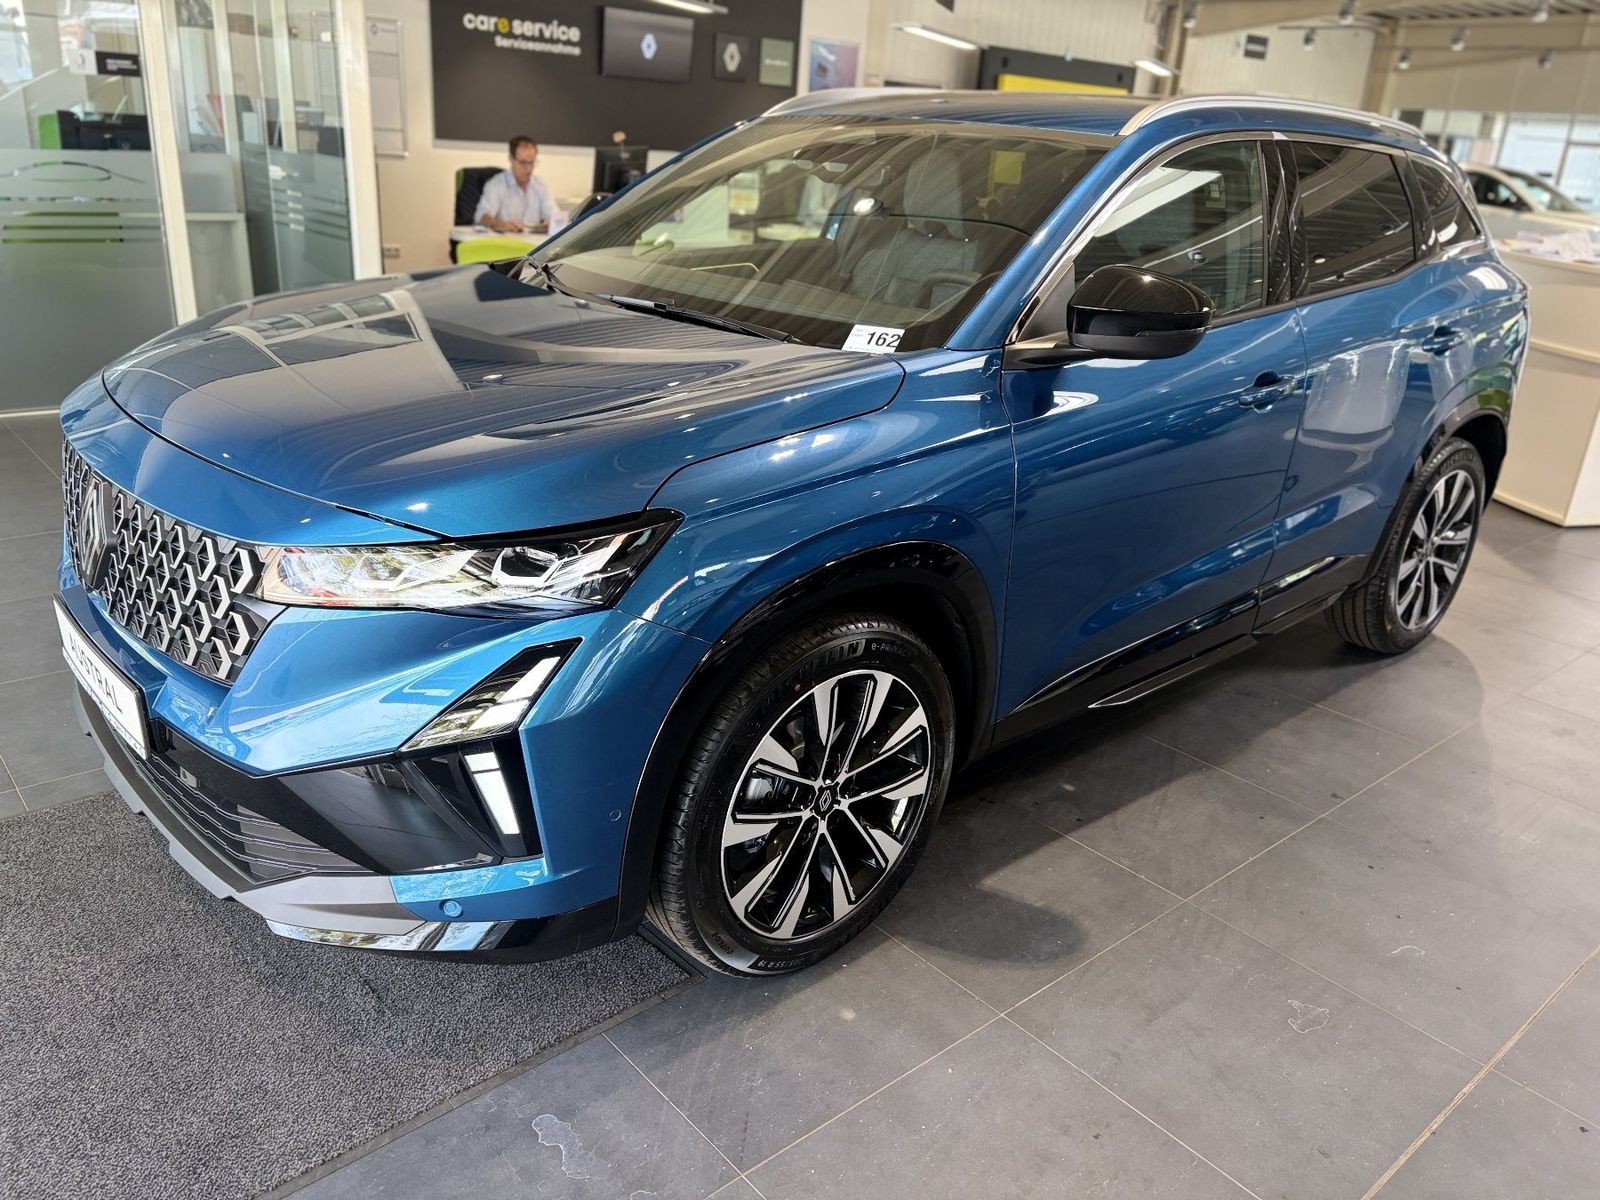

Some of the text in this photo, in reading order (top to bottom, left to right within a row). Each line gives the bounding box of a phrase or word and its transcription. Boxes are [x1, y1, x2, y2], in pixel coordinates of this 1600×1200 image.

[462, 12, 581, 42] care service
[494, 34, 582, 56] Serviceannahme
[866, 331, 902, 348] 162
[69, 631, 123, 716] AUSTRAL
